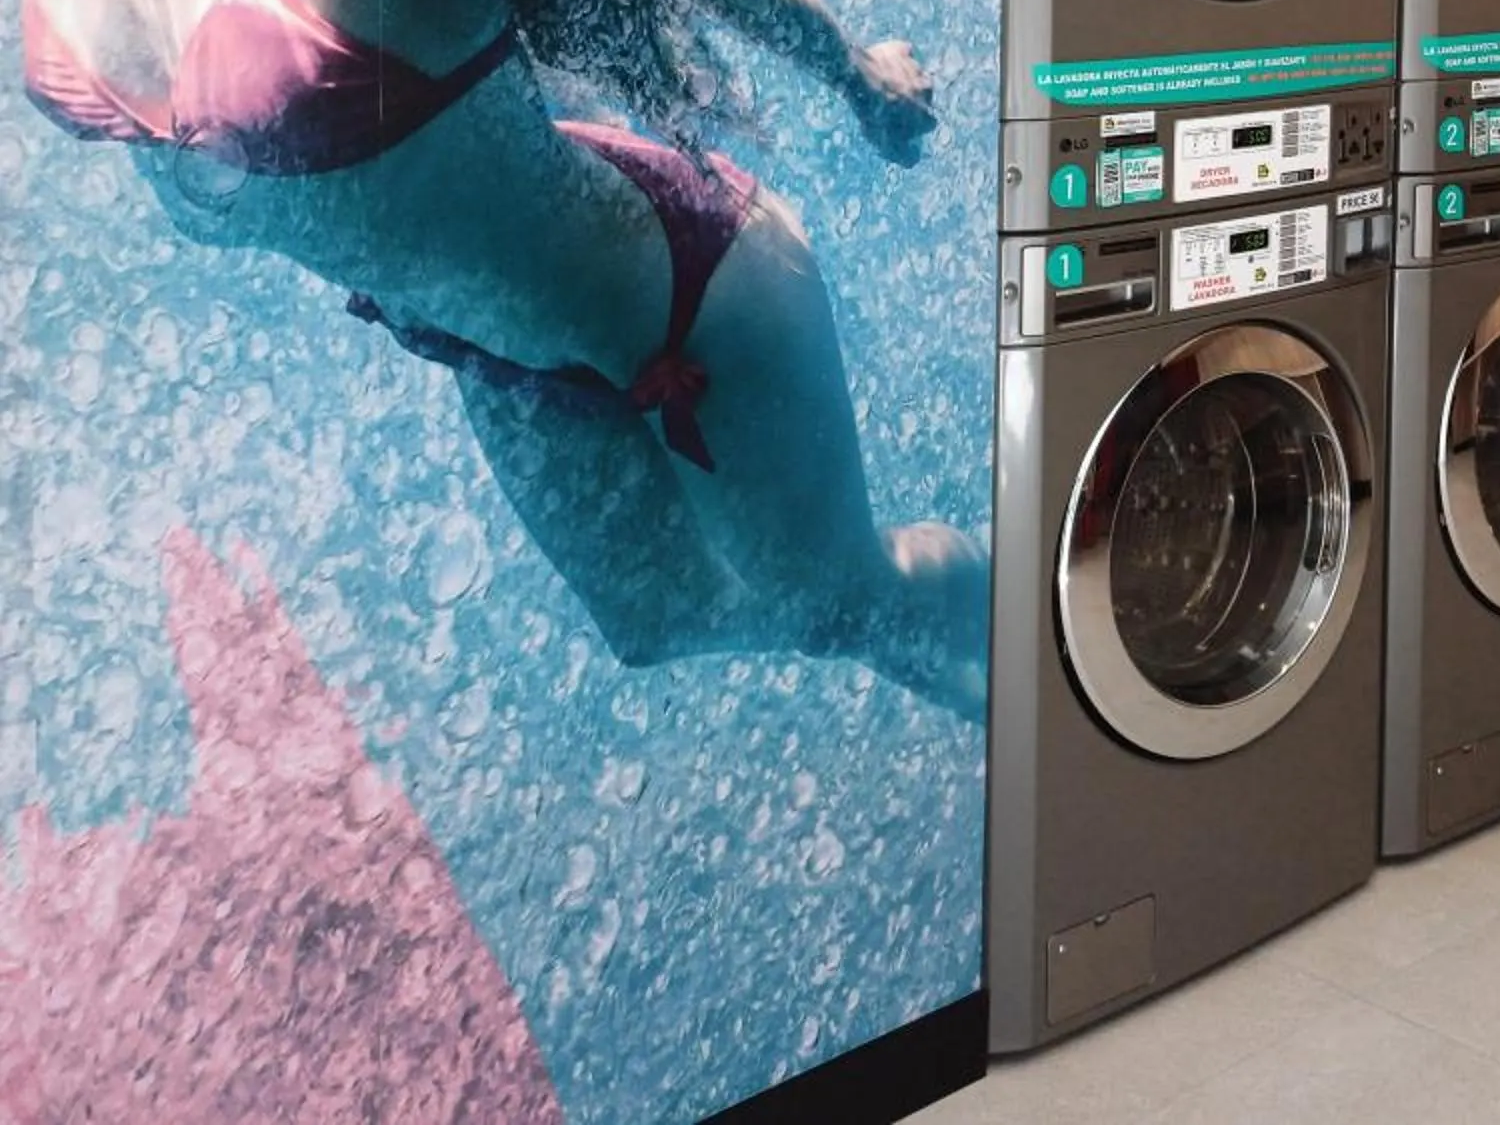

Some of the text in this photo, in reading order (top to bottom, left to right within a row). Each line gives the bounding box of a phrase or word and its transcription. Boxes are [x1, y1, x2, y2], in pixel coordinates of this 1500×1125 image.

[1073, 138, 1089, 150] LG
[1446, 122, 1458, 146] 2
[1064, 172, 1073, 200] 1
[1341, 194, 1368, 210] PRICE
[1445, 191, 1457, 214] 2
[1059, 252, 1070, 281] 1
